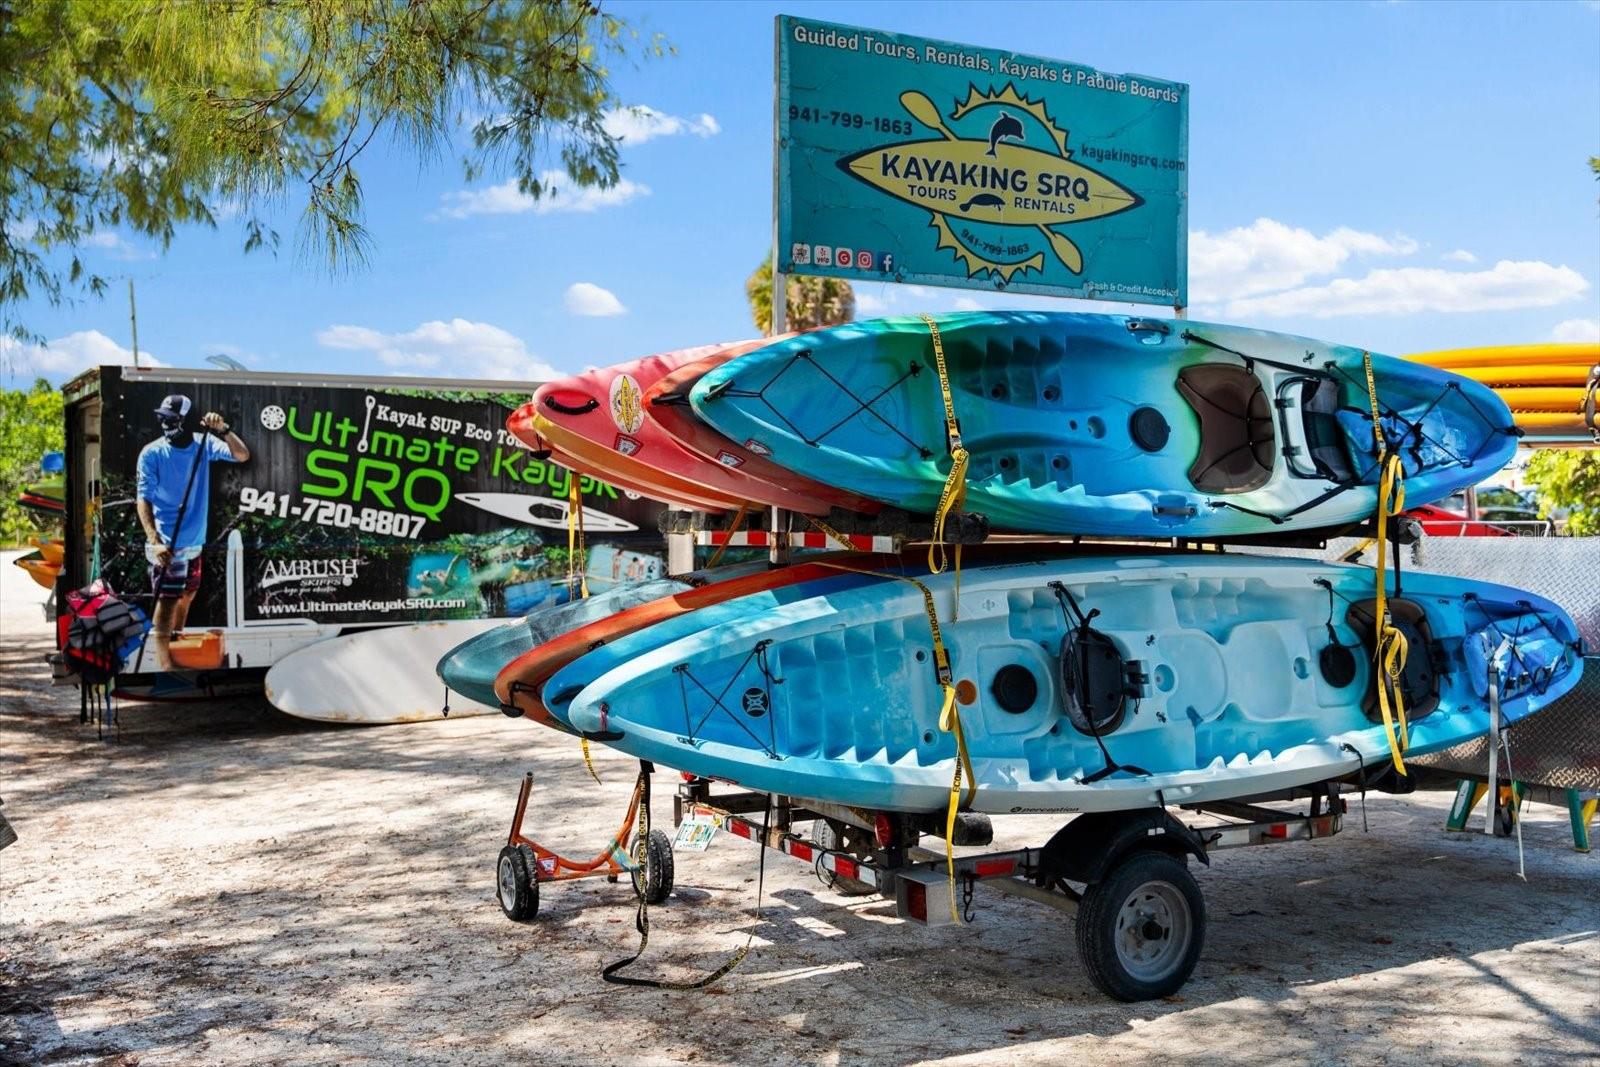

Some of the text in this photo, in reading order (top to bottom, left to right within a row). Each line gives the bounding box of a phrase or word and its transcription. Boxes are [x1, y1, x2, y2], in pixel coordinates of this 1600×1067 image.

[794, 25, 1179, 104] Guided Tours, Rentals, Kayaks & Paddle Boards
[788, 104, 913, 136] 941-799-1863
[1081, 144, 1186, 172] kayakingsrq.com
[881, 152, 1090, 201] KAYAKING SRQ
[907, 184, 957, 201] TOURS
[1014, 197, 1076, 215] RENTALS
[960, 228, 1031, 256] 941-799-1863
[1117, 284, 1141, 293] Credit
[936, 352, 950, 392] DOLPHIN
[376, 404, 525, 448] Kayak SUP Eco Tou
[944, 396, 957, 430] TACKLE
[301, 449, 451, 522] SRQ
[239, 487, 427, 540] 941-720-8807
[261, 558, 359, 583] AMBUSH
[300, 578, 342, 587] SKIFFS
[257, 597, 466, 616] www.UltimateKayakSRQ.com
